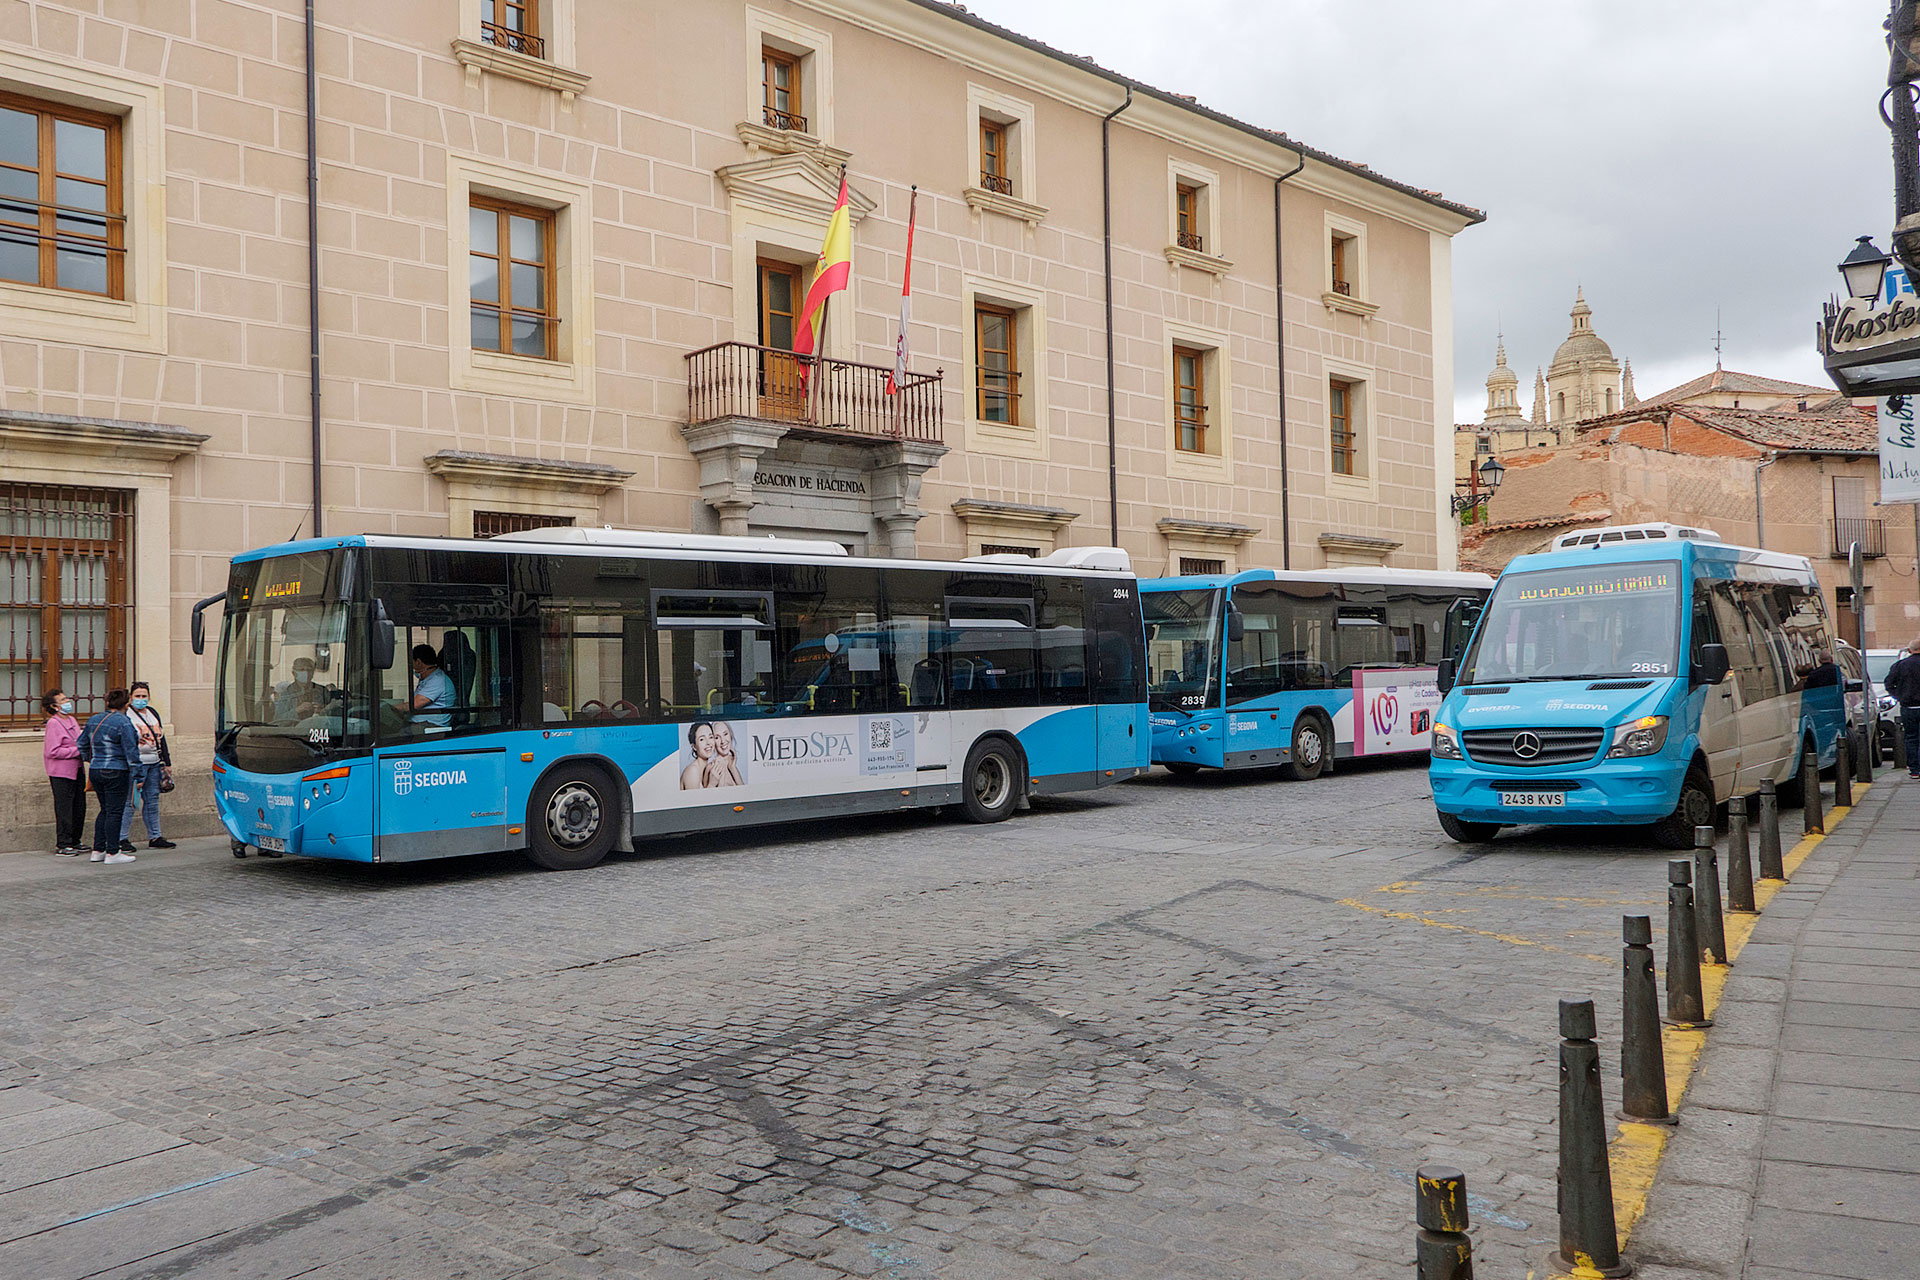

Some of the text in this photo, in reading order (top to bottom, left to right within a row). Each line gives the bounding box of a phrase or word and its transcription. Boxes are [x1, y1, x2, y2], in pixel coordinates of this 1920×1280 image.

[1832, 300, 1920, 344] hoste
[800, 476, 813, 489] DE
[817, 479, 866, 494] HACIENDA
[1113, 588, 1130, 599] 2844
[1631, 662, 1669, 673] 2851
[1181, 695, 1206, 706] 2839
[1562, 703, 1609, 711] SEGOVIA
[1236, 721, 1258, 731] SEGOVIA
[309, 728, 330, 743] 2844
[414, 770, 467, 788] SEGOVIA
[274, 795, 295, 807] SEGOVIA
[1505, 794, 1562, 805] 2438 KVS
